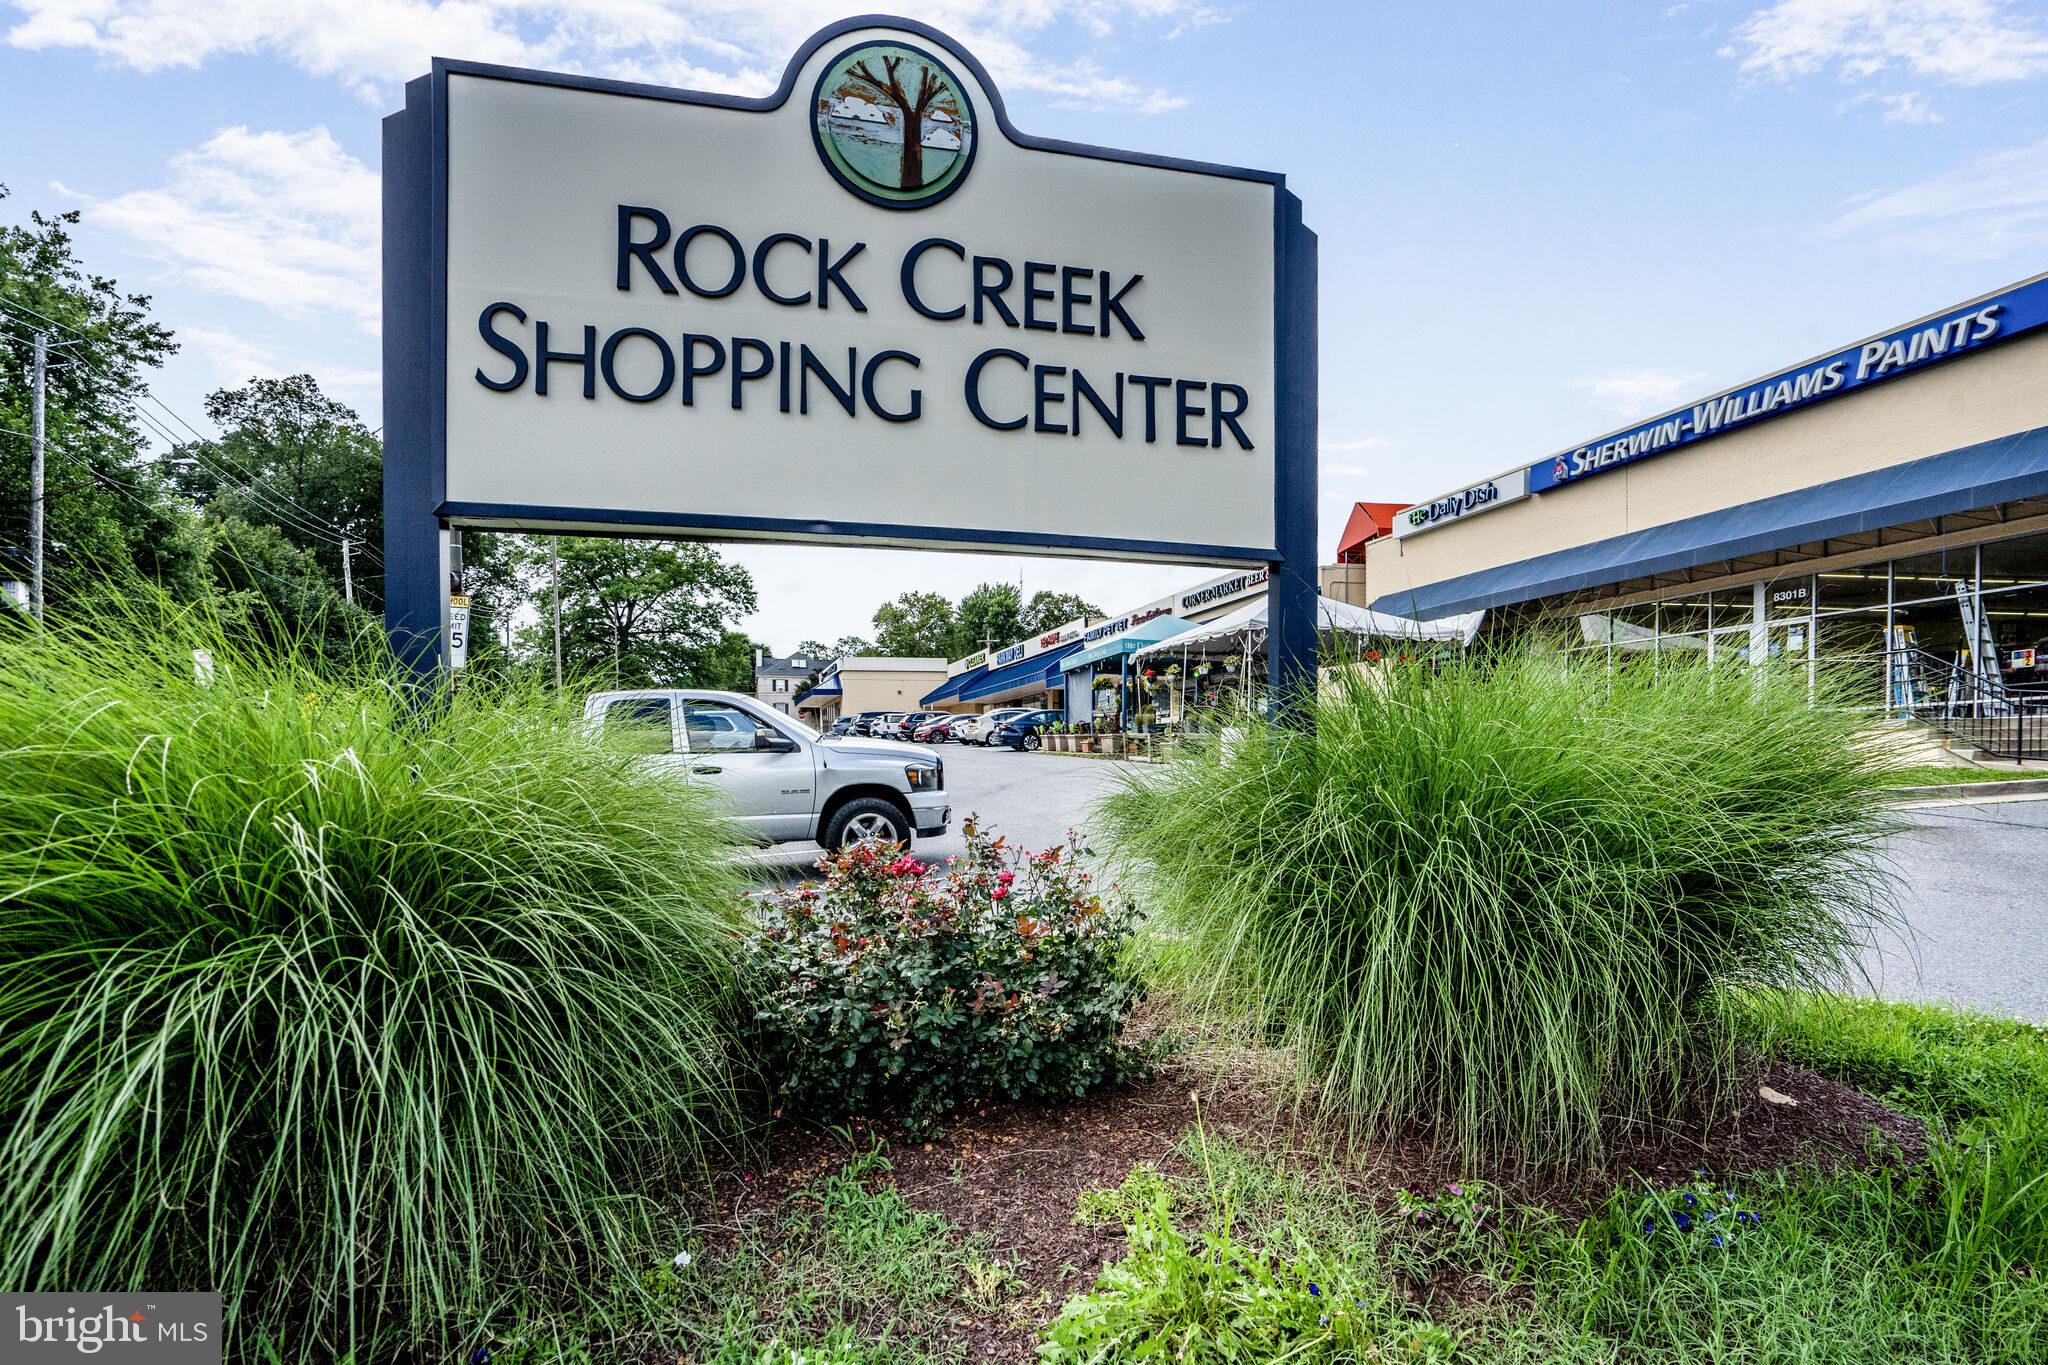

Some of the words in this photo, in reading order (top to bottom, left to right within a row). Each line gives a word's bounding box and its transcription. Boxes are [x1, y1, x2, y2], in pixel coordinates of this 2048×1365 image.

[616, 204, 868, 313] ROCK
[900, 237, 1146, 341] CREEK
[474, 301, 922, 423] SHOPPING
[964, 347, 1255, 450] CENTER
[1570, 360, 1846, 477] SHERWIN-WILLIAMS
[1856, 304, 2001, 380] PAINTS
[1429, 496, 1462, 521] Daily
[1462, 481, 1498, 510] Dish
[1210, 575, 1247, 600] MARKET
[1247, 570, 1265, 585] BEER
[1773, 588, 1807, 602] 8301B
